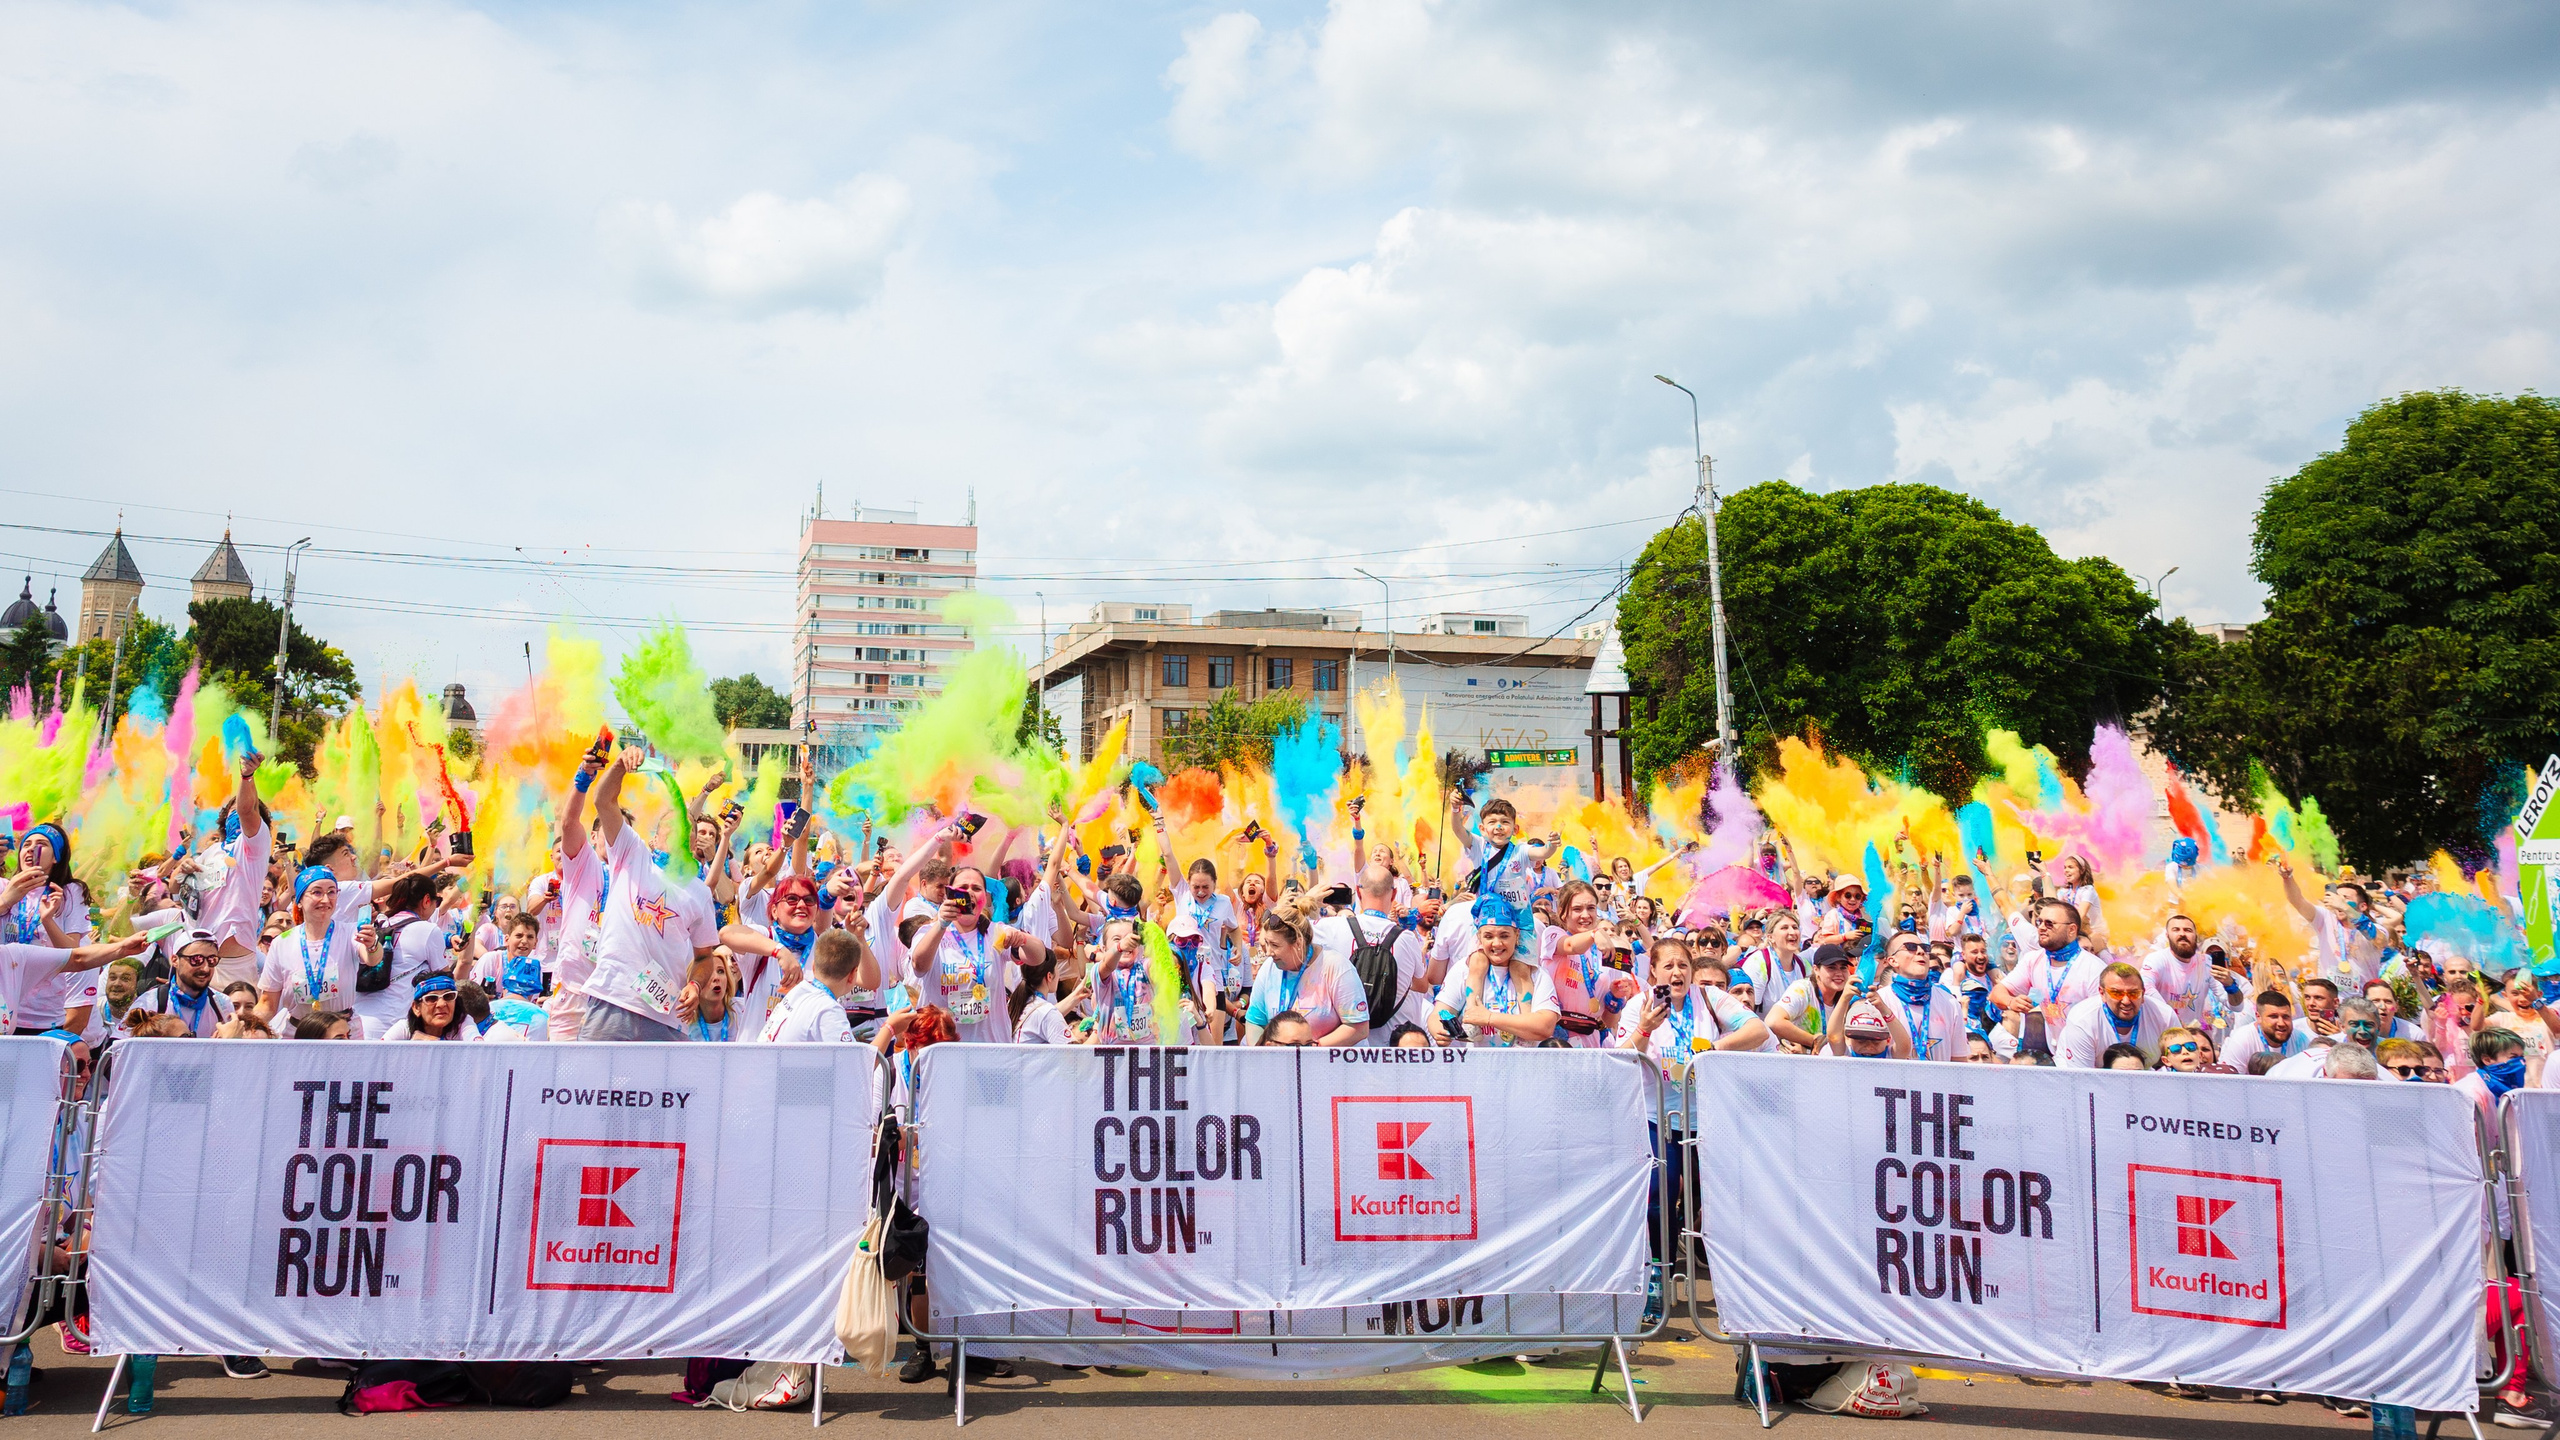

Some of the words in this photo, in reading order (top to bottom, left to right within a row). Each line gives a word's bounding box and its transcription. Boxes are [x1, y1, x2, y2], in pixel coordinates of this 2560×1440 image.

[1505, 753, 1541, 762] ADMITERE
[2521, 850, 2552, 861] Pentru
[942, 962, 957, 974] THE
[1570, 960, 1581, 971] THE
[646, 979, 668, 1004] 18124
[941, 973, 970, 986] COLOR
[1565, 978, 1578, 989] RUN
[960, 1002, 982, 1015] 15126
[1329, 1048, 1435, 1064] POWERED
[1443, 1048, 1468, 1064] BY
[1094, 1046, 1188, 1111] THE
[541, 1087, 653, 1108] POWERED
[661, 1092, 690, 1109] BY
[294, 1081, 393, 1149] THE
[1874, 1086, 1975, 1161] THE
[2126, 1113, 2242, 1141] POWERED
[2250, 1126, 2280, 1145] BY
[1094, 1114, 1263, 1182] COLOR
[282, 1153, 462, 1223] COLOR
[1875, 1157, 2054, 1240] COLOR
[1351, 1194, 1461, 1216] Kaufland
[1095, 1186, 1197, 1255] RUN
[275, 1227, 387, 1298] RUN
[545, 1240, 660, 1265] Kaufland
[1876, 1227, 1983, 1305] RUN
[2149, 1266, 2268, 1301] Kaufland
[1852, 1401, 1902, 1417] RE:FRESH
